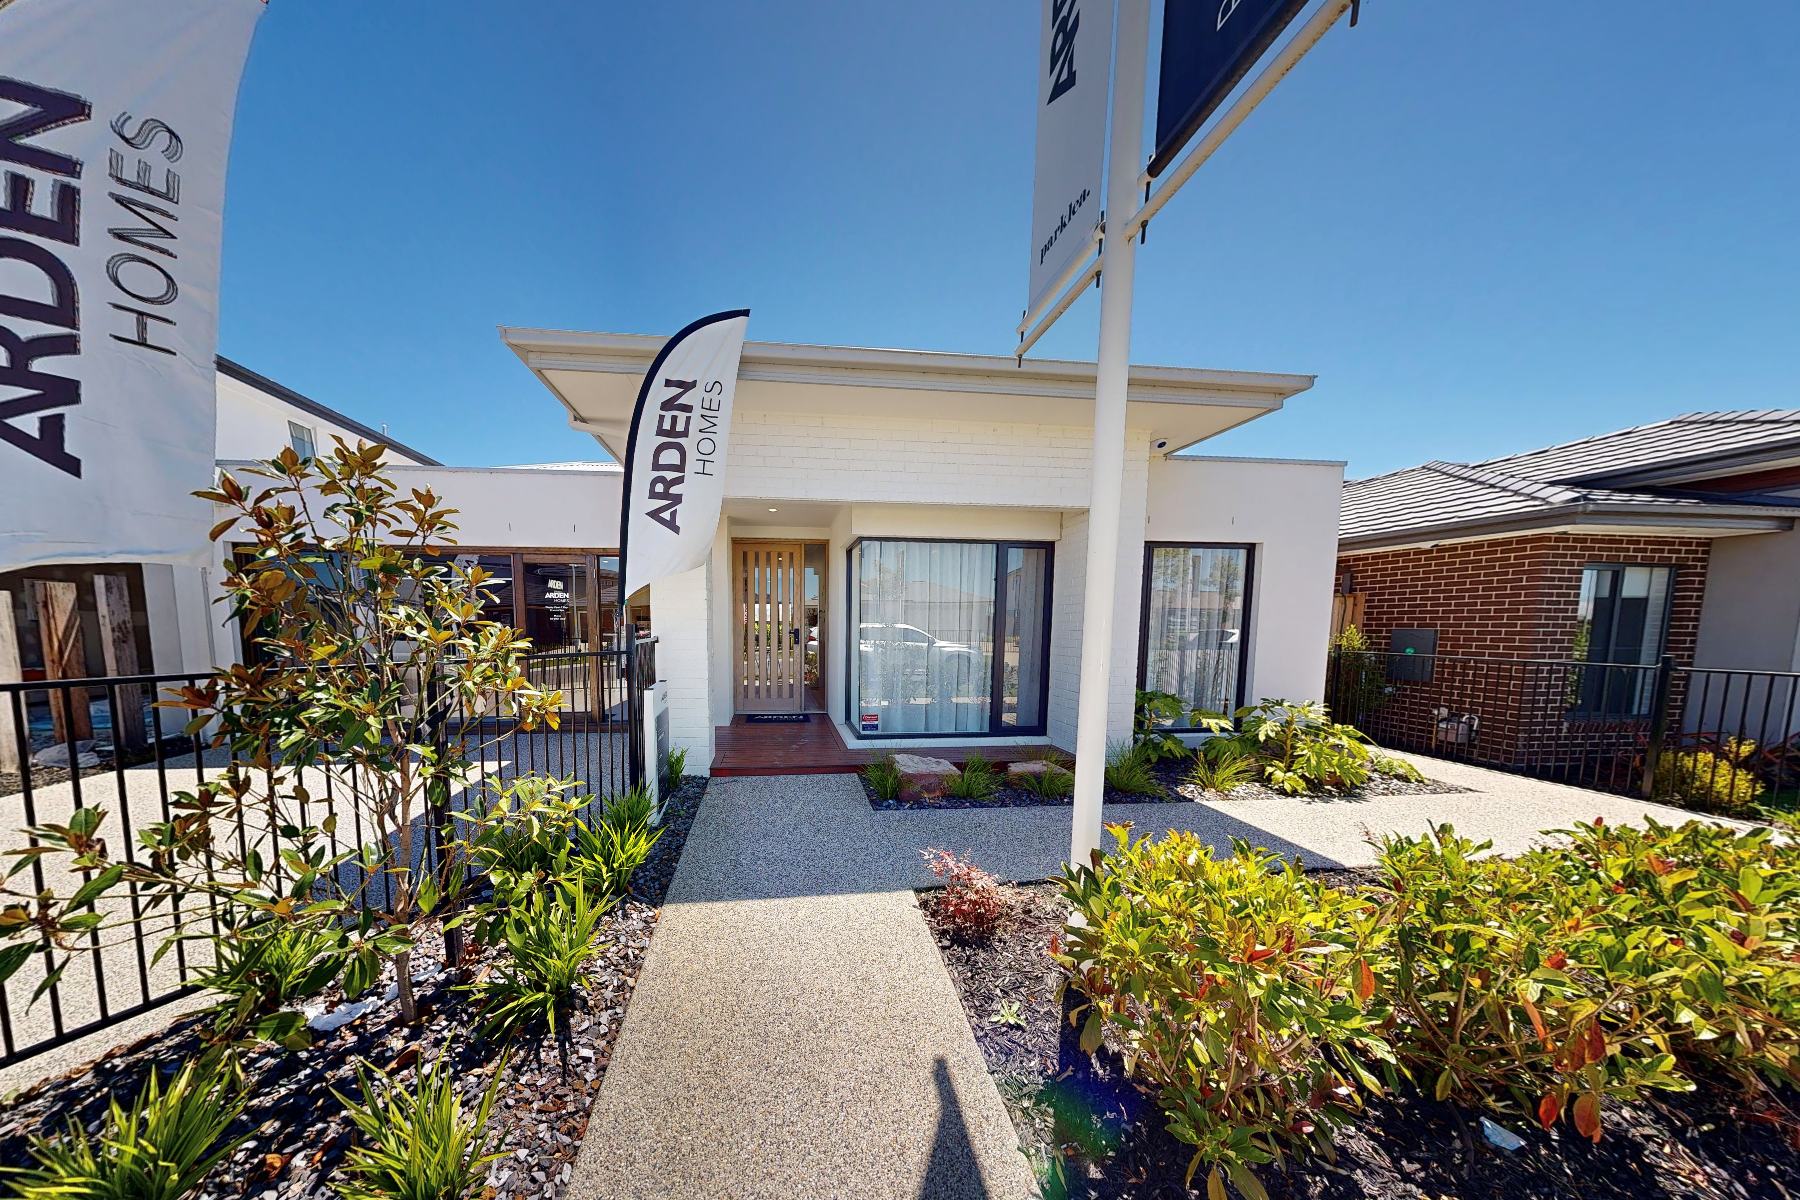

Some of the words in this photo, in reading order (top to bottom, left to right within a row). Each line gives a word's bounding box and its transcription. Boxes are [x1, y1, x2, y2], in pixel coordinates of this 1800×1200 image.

[106, 110, 184, 356] HOMES
[644, 378, 698, 536] ARDEN
[694, 380, 723, 477] HOMES
